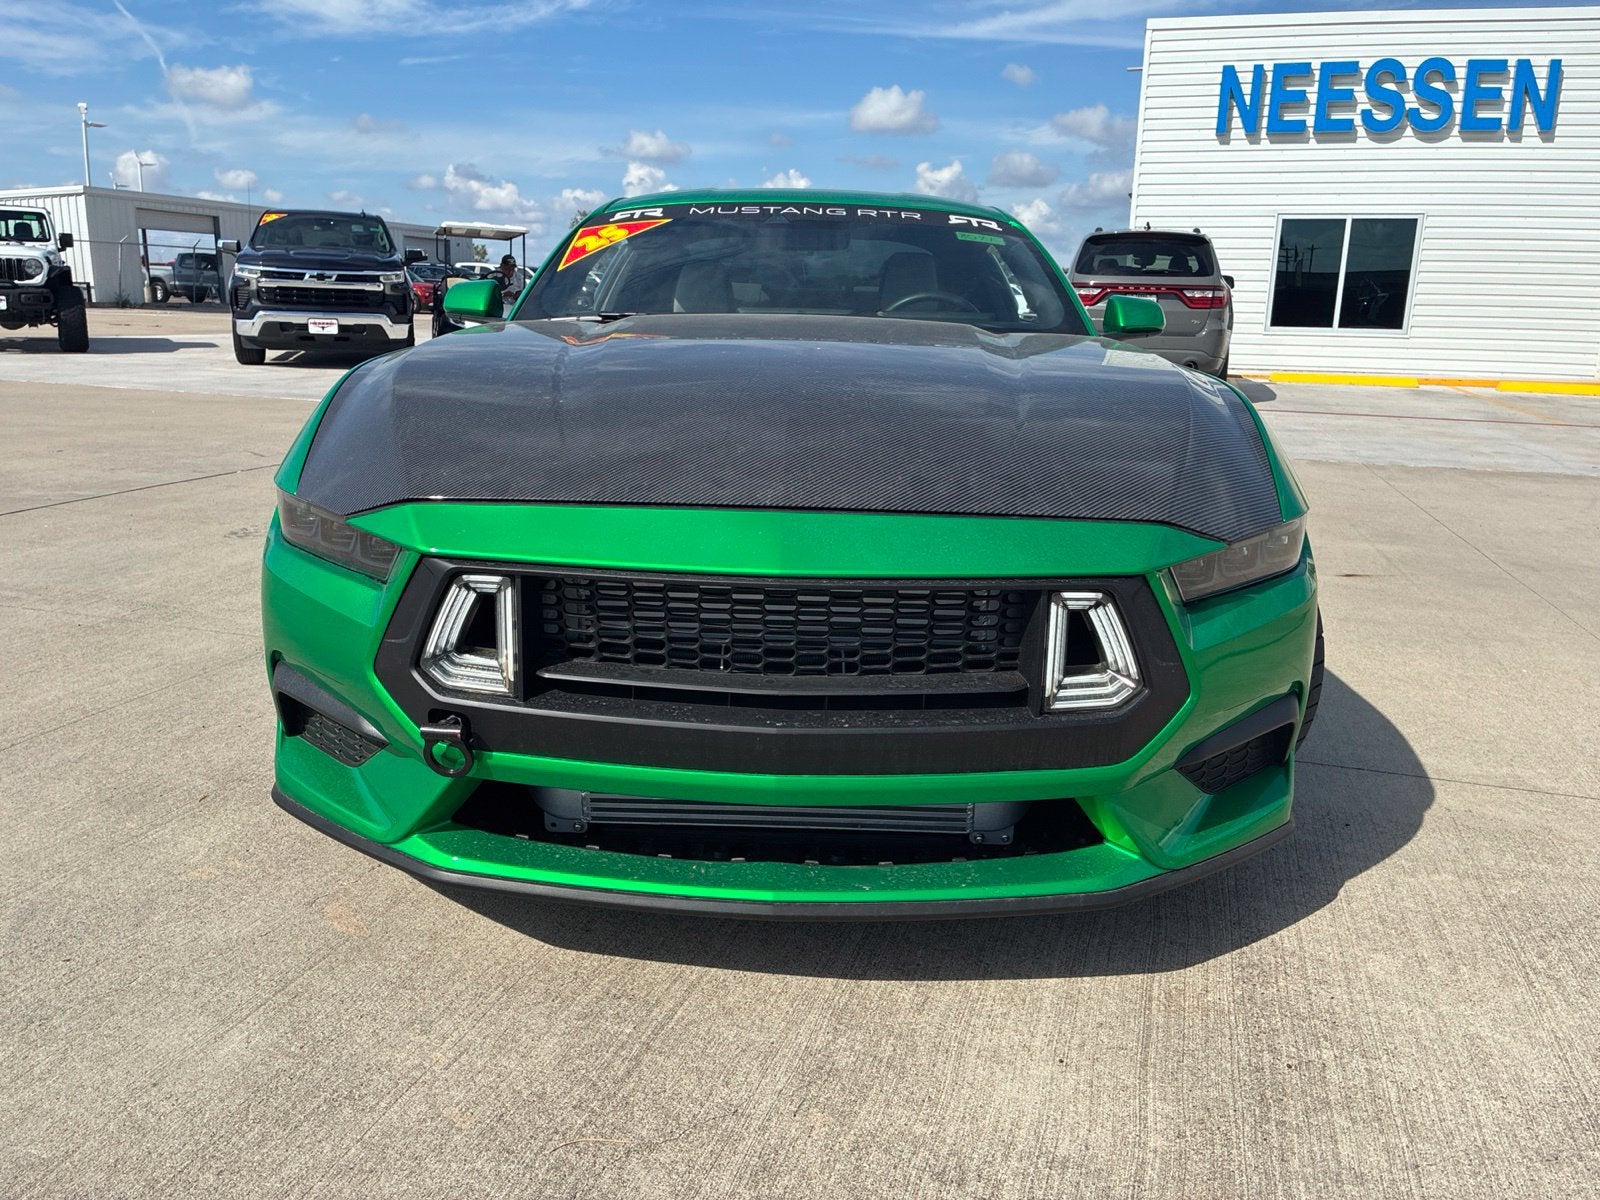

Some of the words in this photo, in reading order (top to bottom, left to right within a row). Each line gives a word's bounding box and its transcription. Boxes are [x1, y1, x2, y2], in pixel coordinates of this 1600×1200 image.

[1216, 57, 1562, 136] NEESSEN
[689, 206, 847, 216] MUSTANG
[857, 208, 921, 220] RTR
[574, 224, 629, 252] 25
